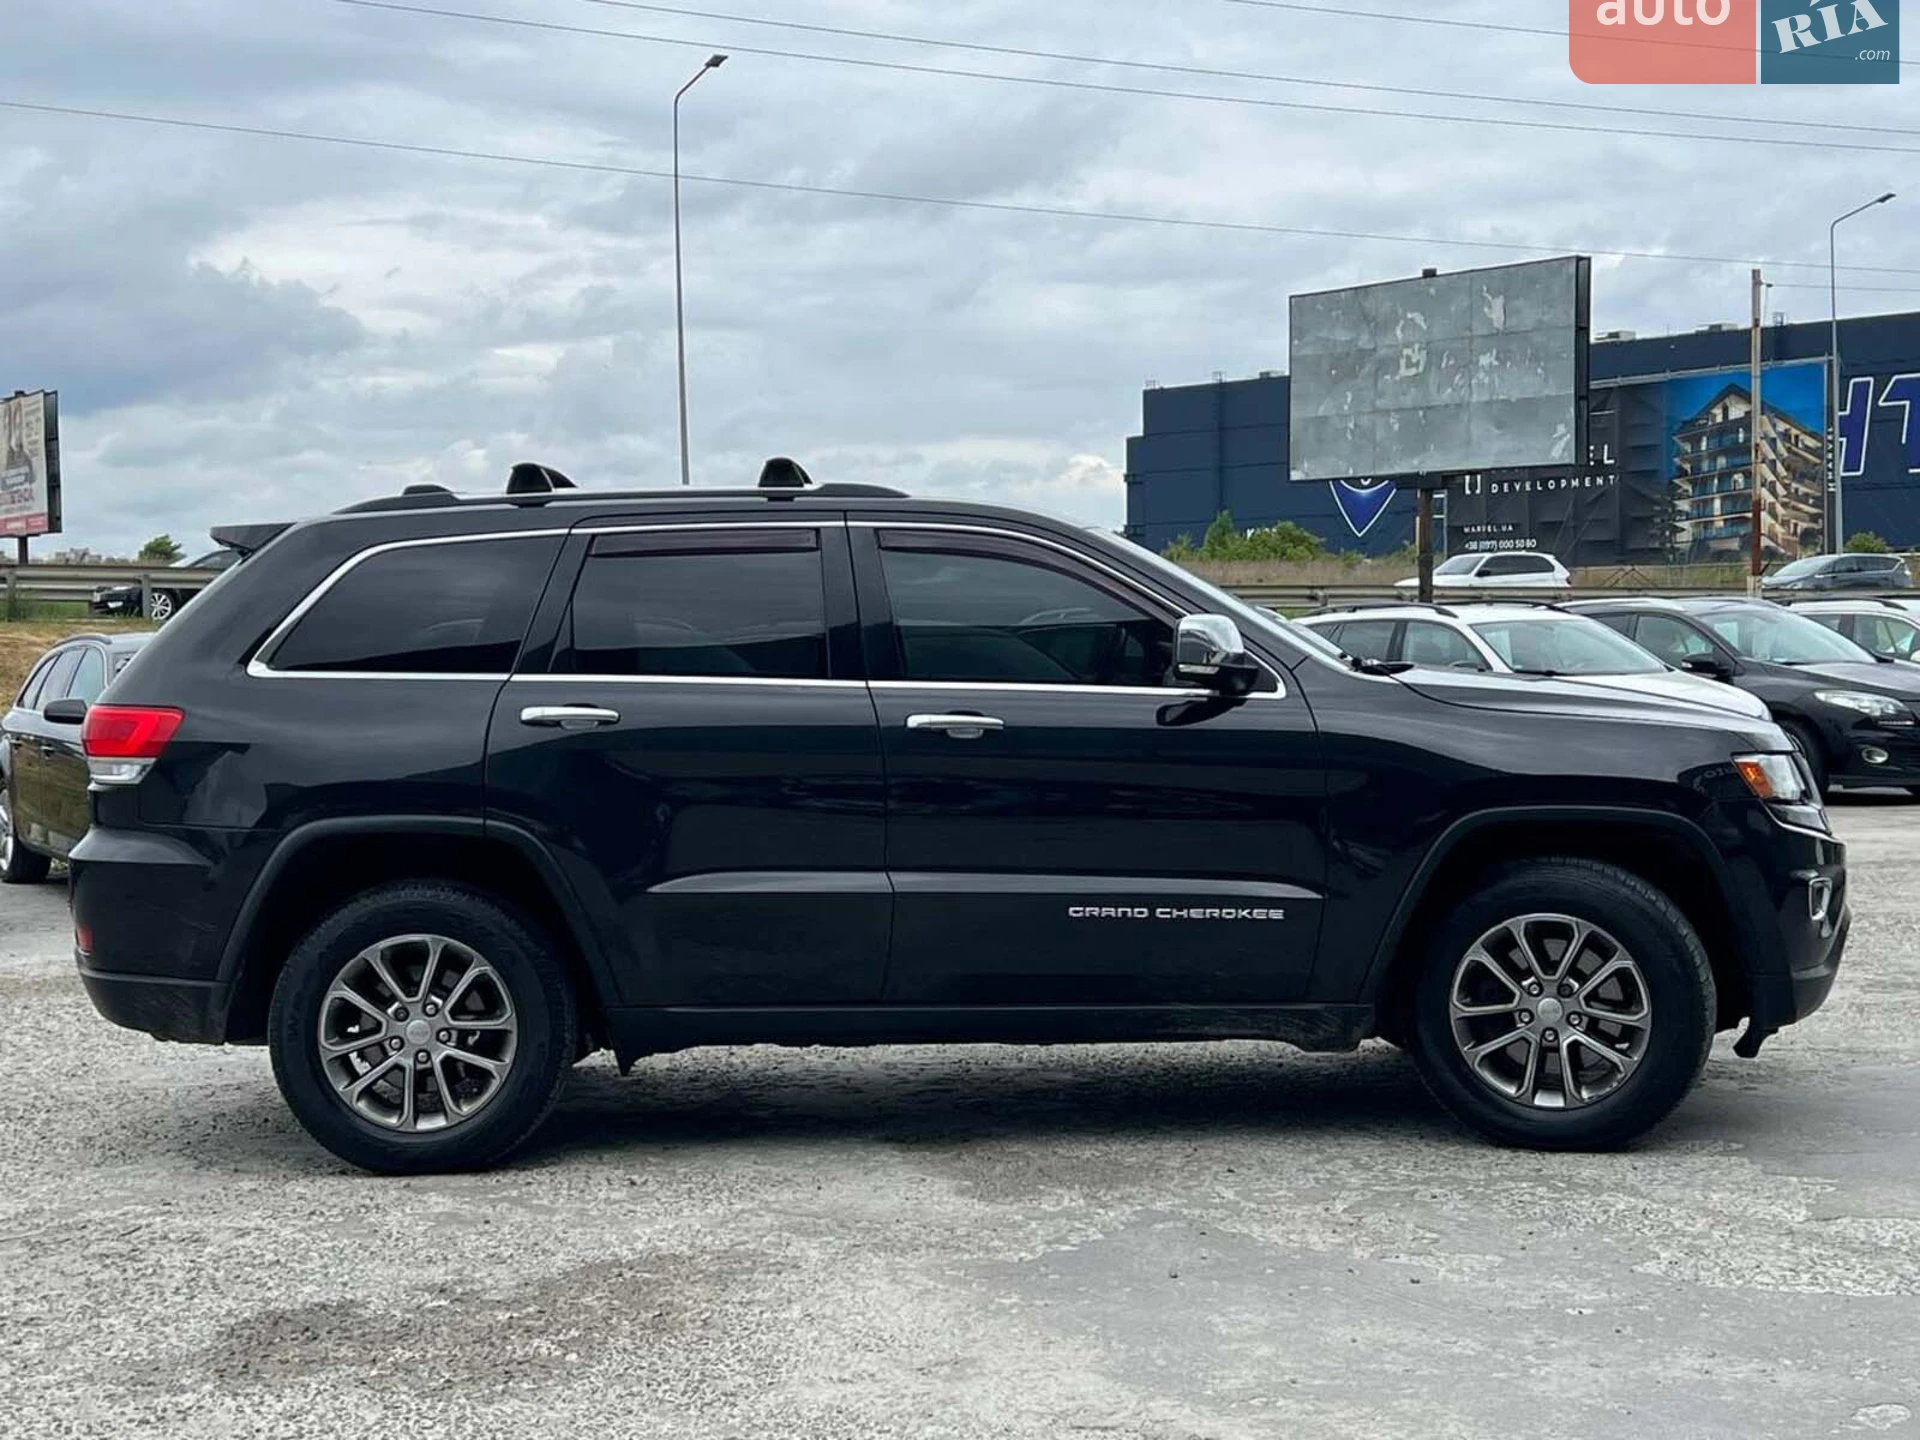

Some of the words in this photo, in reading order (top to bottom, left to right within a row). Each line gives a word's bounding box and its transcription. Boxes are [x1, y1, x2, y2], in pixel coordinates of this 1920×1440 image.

[1490, 474, 1616, 494] DEVELOPMENT
[1068, 907, 1149, 918] GRAND
[1155, 908, 1285, 919] CHEROKEE
